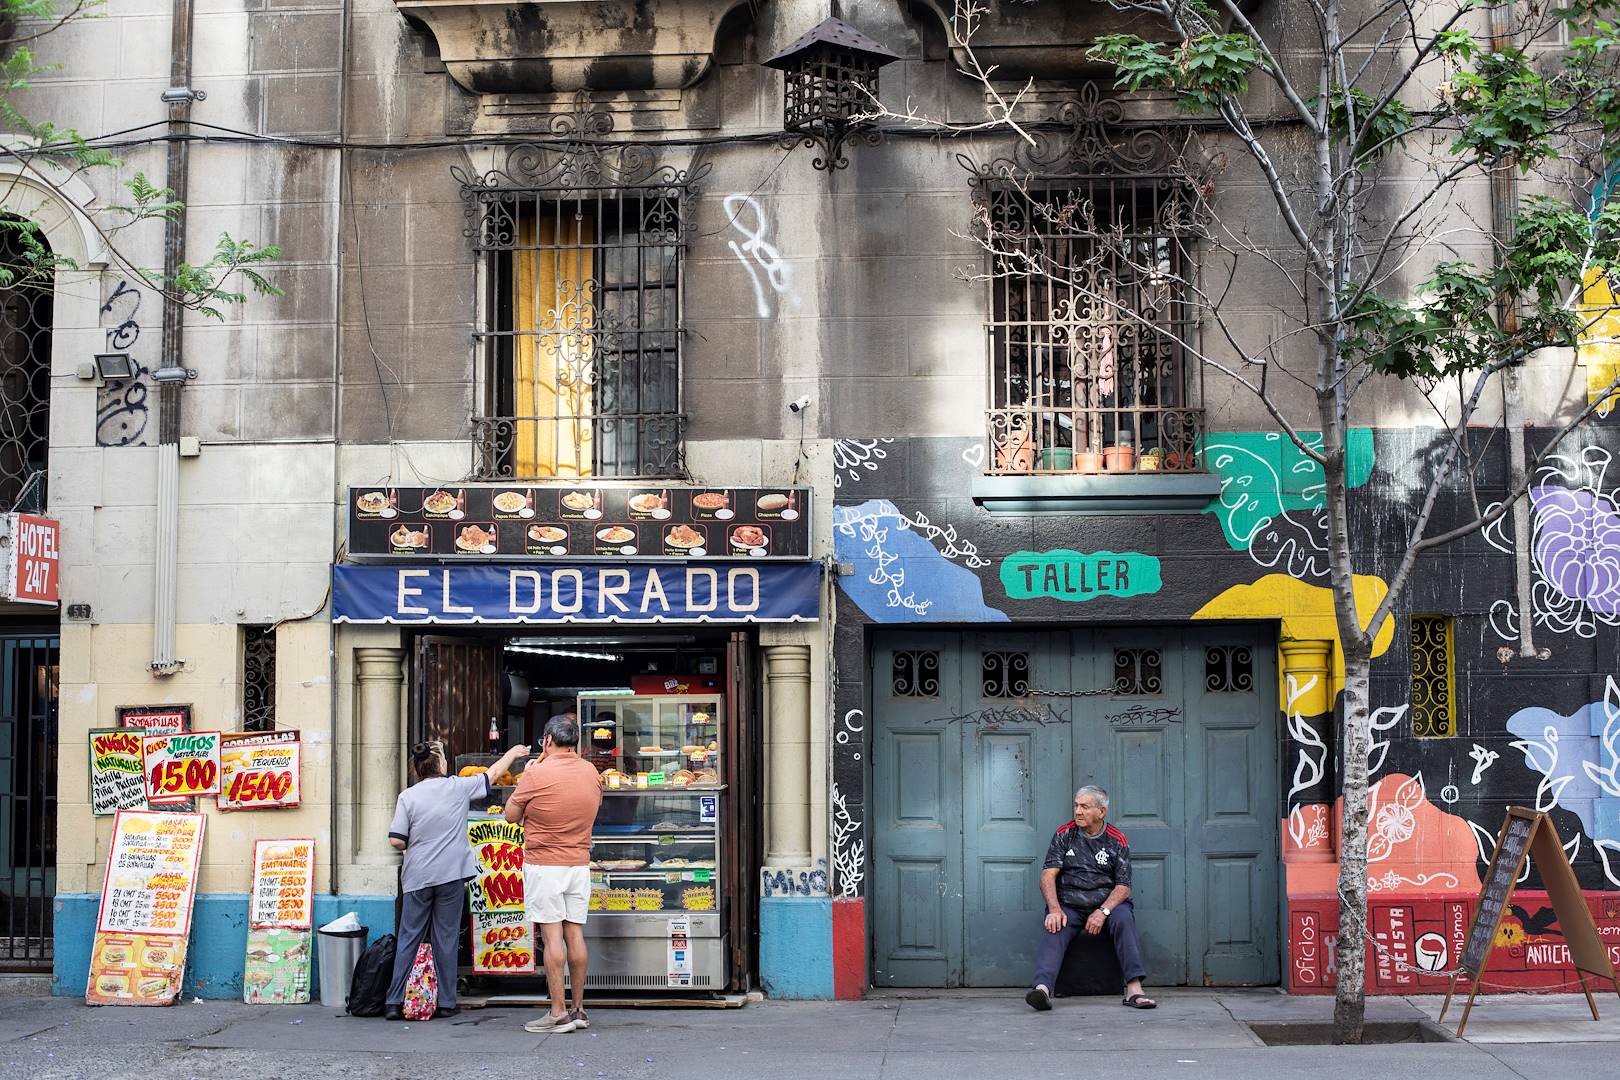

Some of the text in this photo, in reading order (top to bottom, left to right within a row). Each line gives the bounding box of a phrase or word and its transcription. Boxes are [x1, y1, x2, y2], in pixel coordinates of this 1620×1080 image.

[20, 522, 58, 560] HOTEL
[25, 559, 50, 594] 24/7
[397, 567, 760, 614] EL DORADO
[1017, 560, 1129, 593] TALLER
[167, 735, 216, 755] JUGOS
[481, 920, 492, 929] DE
[486, 926, 526, 945] 600
[1296, 916, 1316, 984] Oficios
[1376, 932, 1392, 980] ANTI
